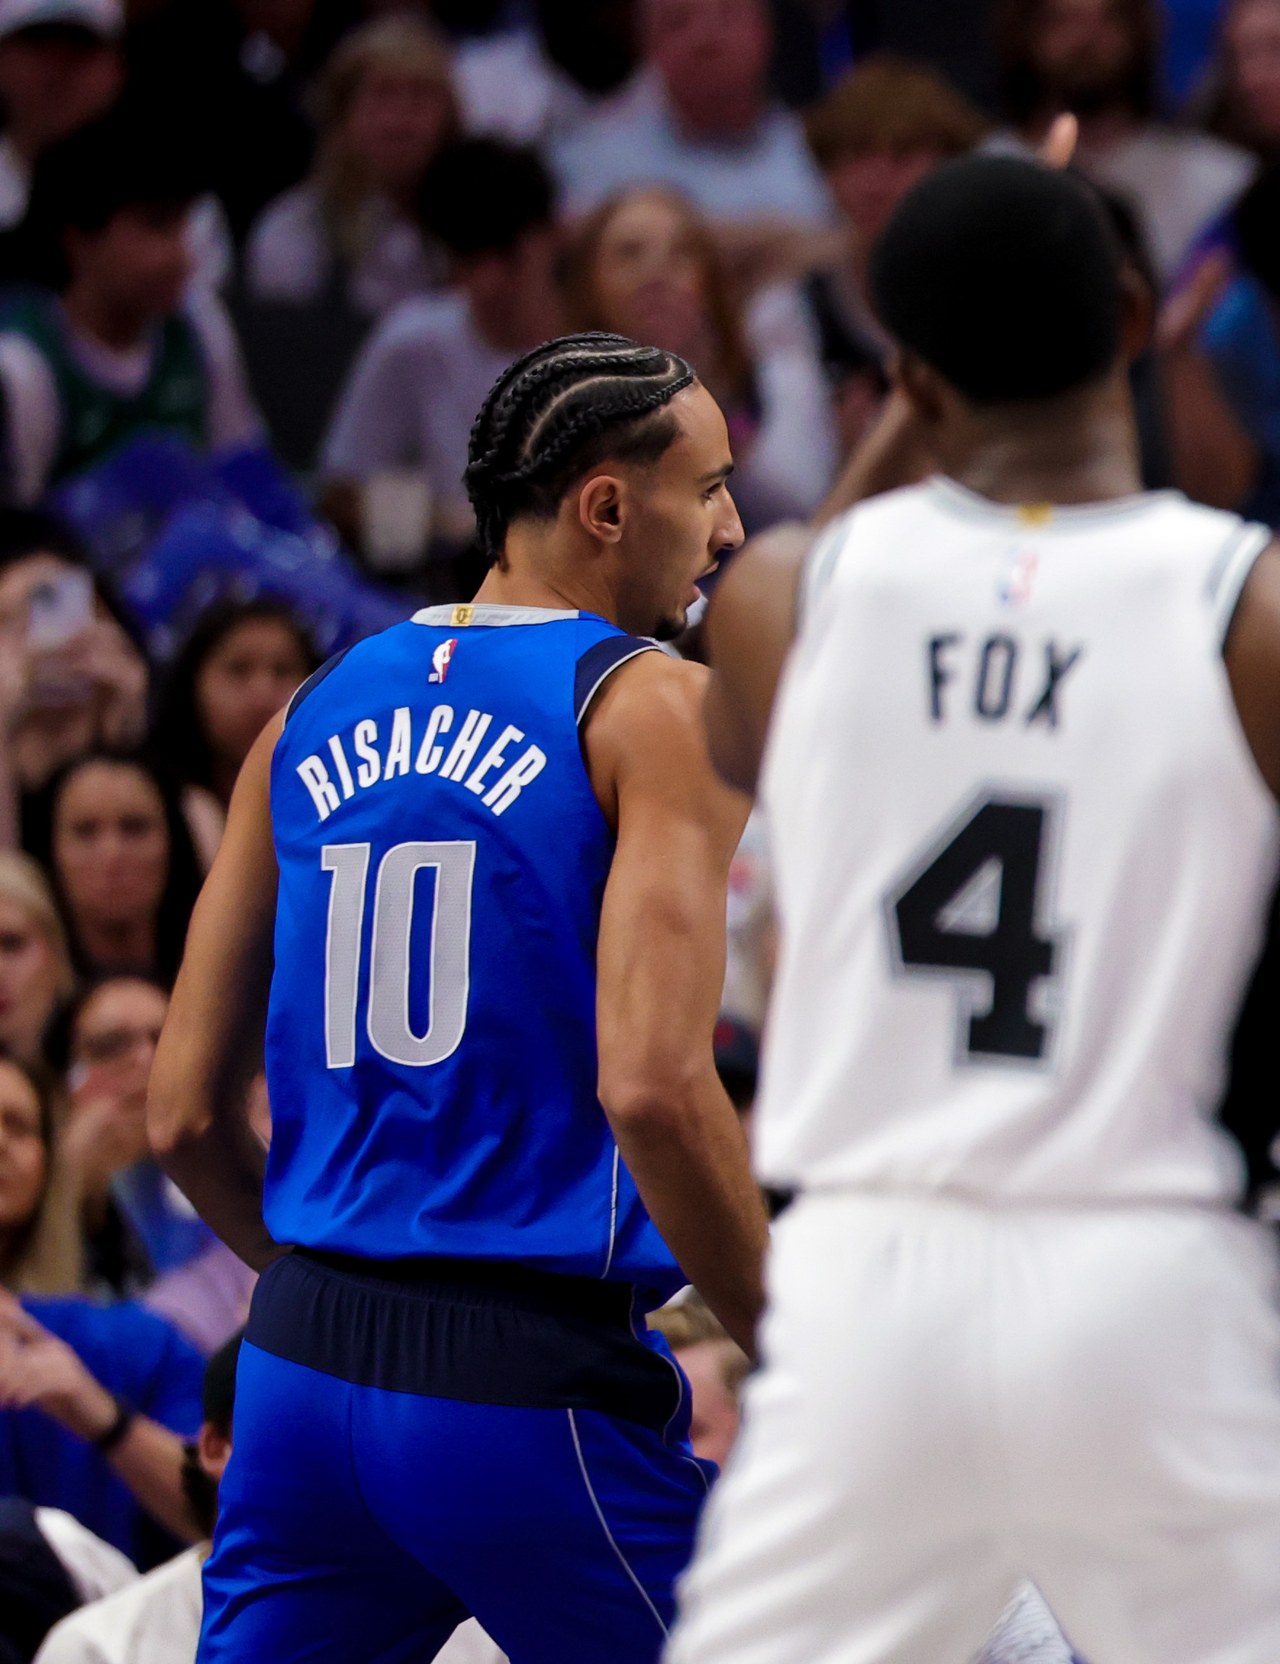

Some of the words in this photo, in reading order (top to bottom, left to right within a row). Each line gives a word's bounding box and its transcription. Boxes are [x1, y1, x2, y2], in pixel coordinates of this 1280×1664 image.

[296, 704, 547, 822] RISACHER
[925, 633, 1085, 735] FOX
[321, 840, 477, 1069] 10
[883, 782, 1071, 1077] 4
